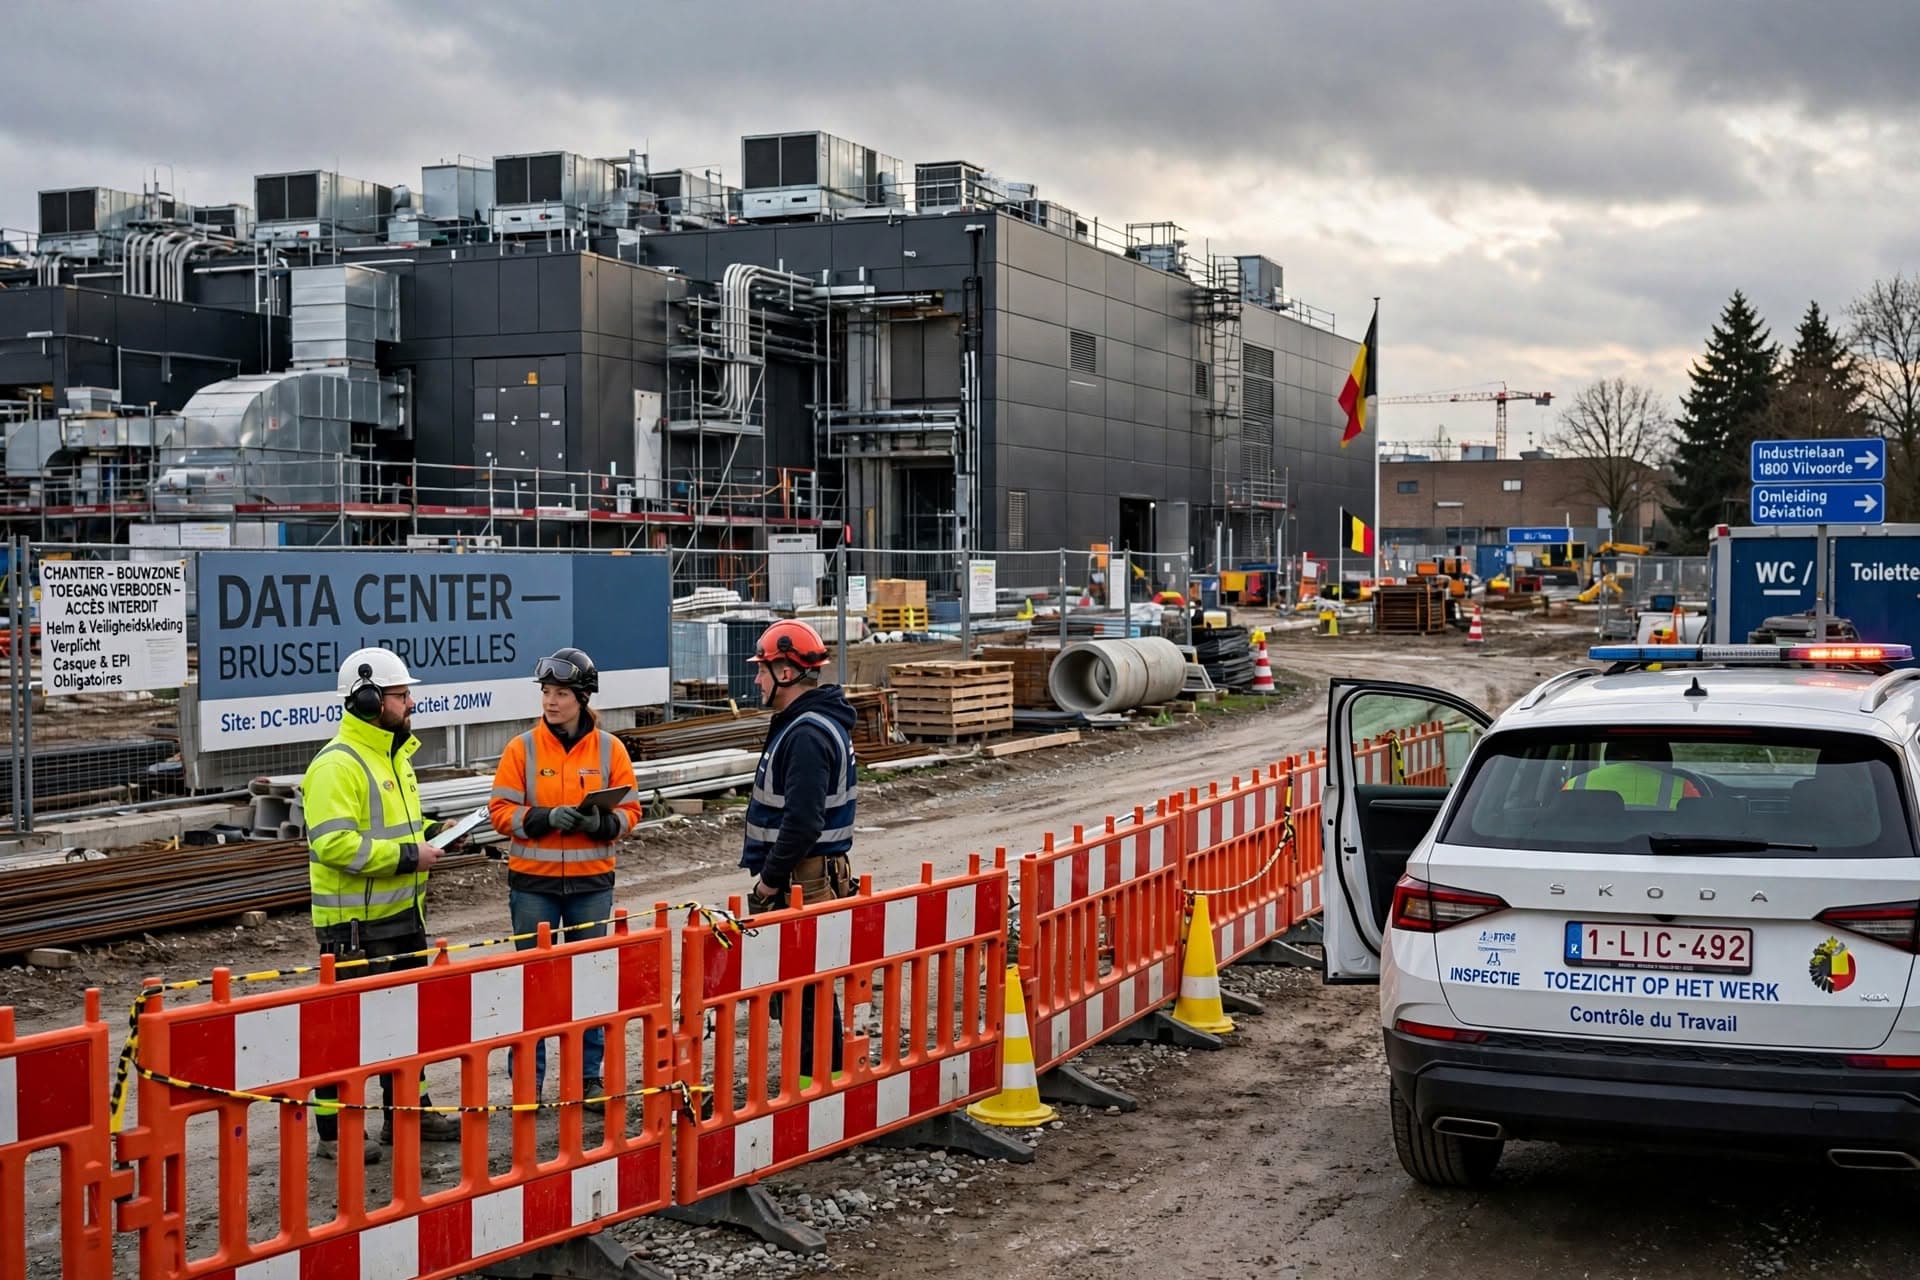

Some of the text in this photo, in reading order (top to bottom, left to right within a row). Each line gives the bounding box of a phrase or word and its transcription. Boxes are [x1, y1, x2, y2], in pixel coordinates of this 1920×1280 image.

[1759, 446, 1844, 459] Industrielaan
[1760, 462, 1853, 475] 1800 Vilvoorde
[1759, 489, 1827, 505] Omleiding
[1759, 505, 1823, 518] Déviation
[44, 566, 104, 580] CHANTIER
[117, 566, 181, 580] BOUWZONE
[1755, 560, 1920, 586] WC / Toilette
[50, 583, 108, 598] TOEGANG
[110, 582, 171, 597] VERBODEN
[65, 598, 158, 615] ACCÈS INTERDIT
[218, 574, 341, 629] DATA
[354, 573, 513, 625] CENTER
[46, 617, 183, 636] Helm & Veiligheidskleding
[51, 638, 101, 656] Verplicht
[53, 654, 130, 672] Casque & EPI
[219, 641, 340, 680] BRUSSEL
[53, 672, 122, 691] Obligatoires
[221, 692, 492, 732] Site: DC-BRU-03 aciteit 20MW
[1549, 883, 1768, 903] SKODA
[1588, 929, 1745, 962] 1-LIC-492
[1450, 967, 1520, 986] INSPECTIE
[1544, 971, 1780, 1001] TOEZICHT OP HET WERK
[1570, 1005, 1738, 1032] Contrôle du Travail
